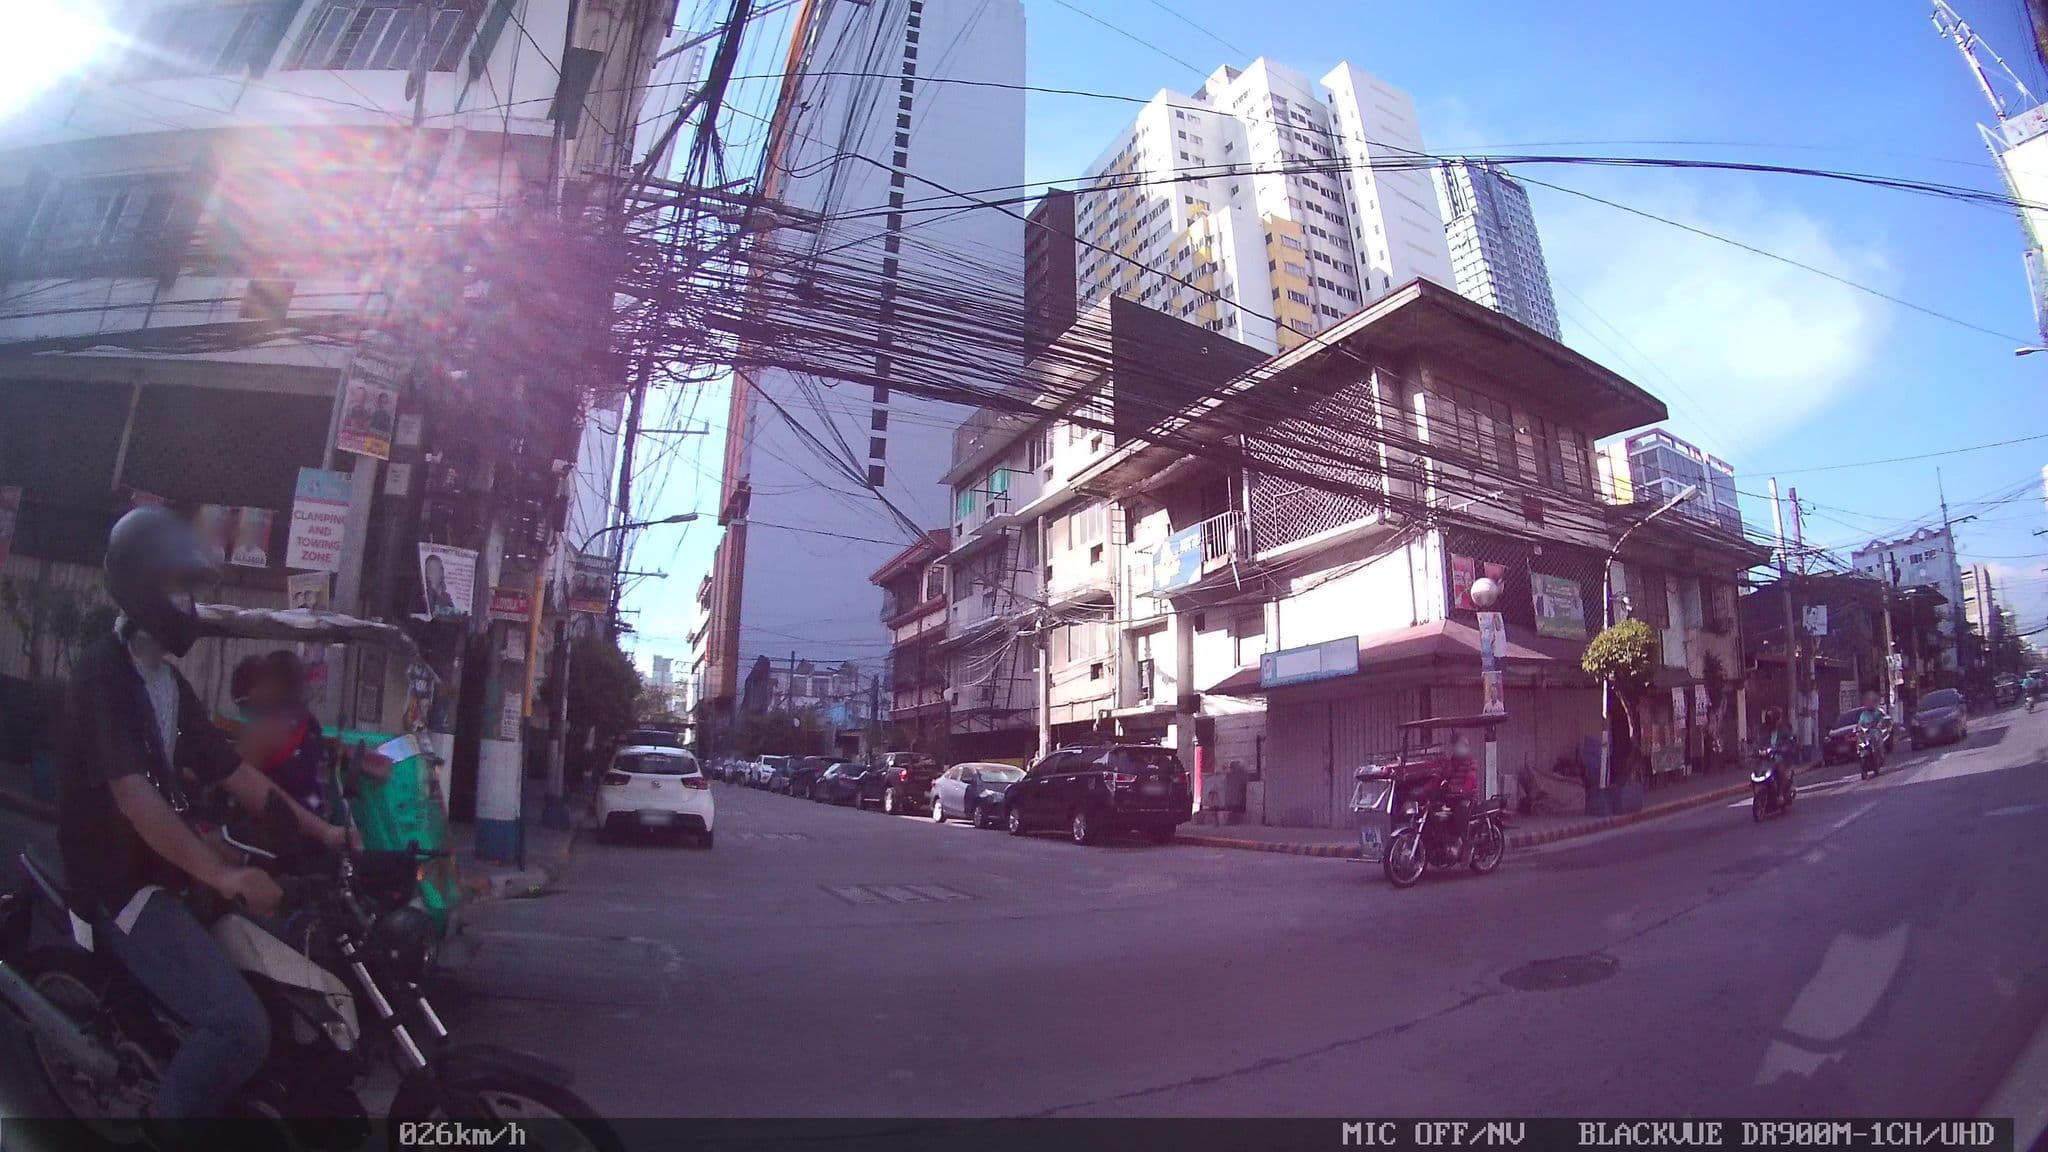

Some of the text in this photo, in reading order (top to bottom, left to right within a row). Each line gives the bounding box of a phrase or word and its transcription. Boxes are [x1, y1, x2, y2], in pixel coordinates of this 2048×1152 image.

[308, 526, 332, 537] AND
[296, 536, 341, 551] TOWING
[302, 551, 332, 563] ZONE
